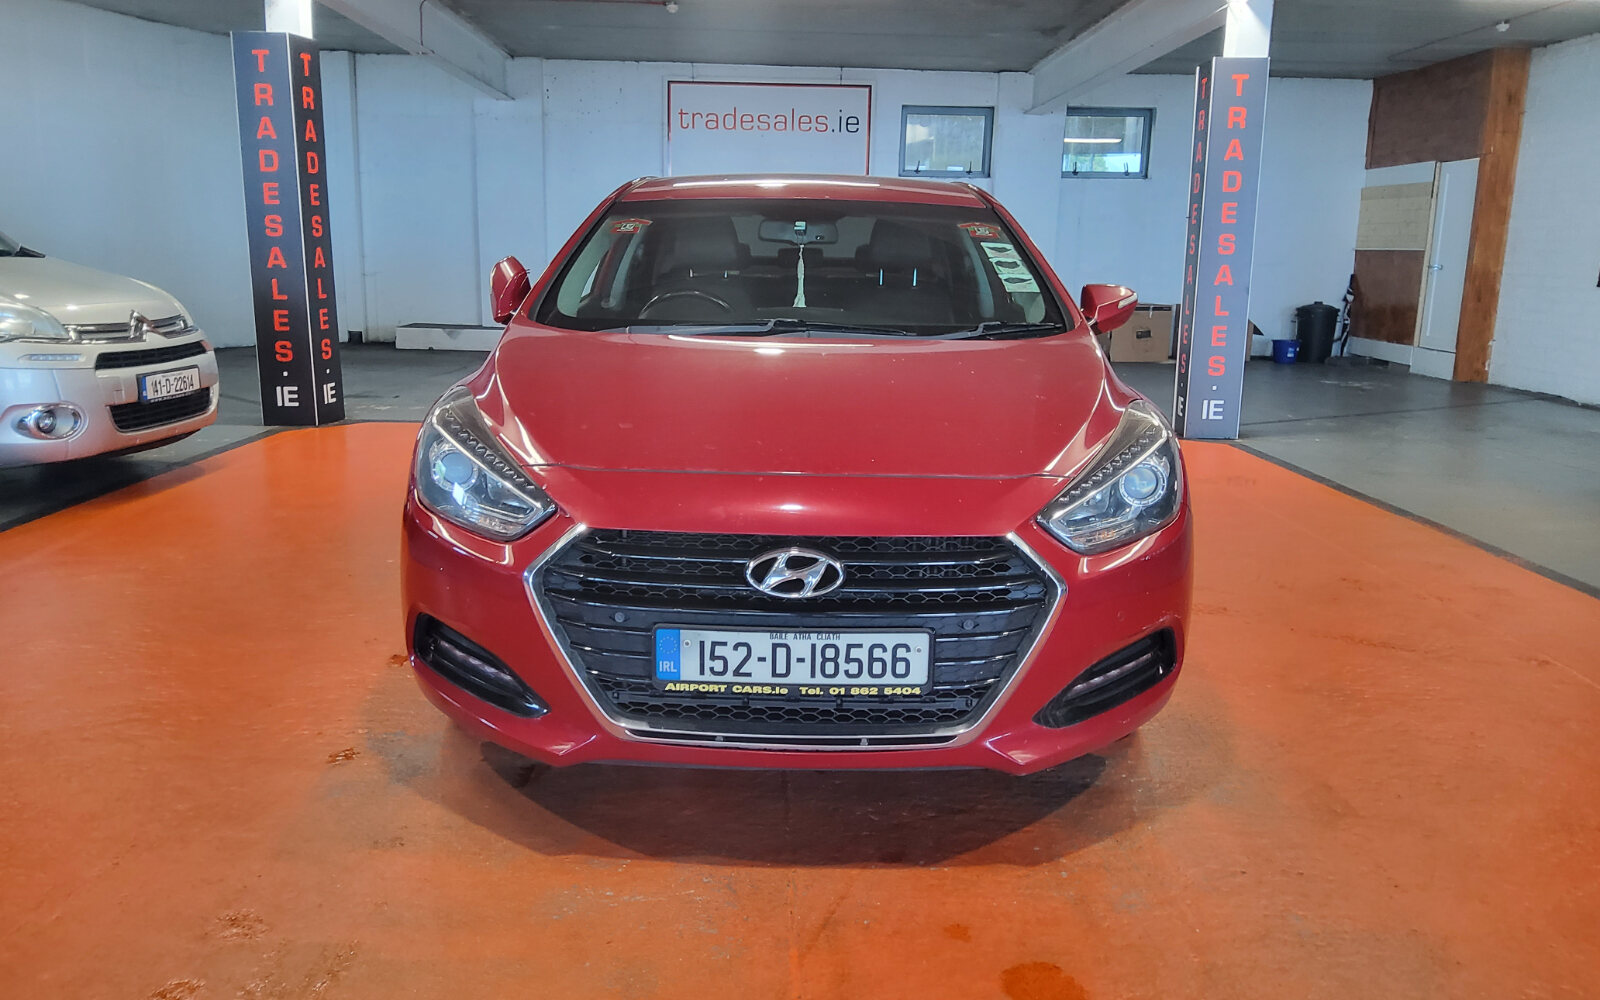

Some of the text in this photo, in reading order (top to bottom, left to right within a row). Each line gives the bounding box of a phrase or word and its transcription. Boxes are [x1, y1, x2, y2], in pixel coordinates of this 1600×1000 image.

[678, 106, 860, 134] tradesales.ie
[151, 374, 194, 397] 141-D-22614
[659, 660, 678, 673] IRL
[699, 640, 912, 679] 152-D-18566
[664, 682, 728, 693] AIRPORT
[799, 686, 824, 696] Tel.
[829, 686, 846, 696] 01
[850, 686, 879, 696] 862
[884, 686, 922, 696] 5404
